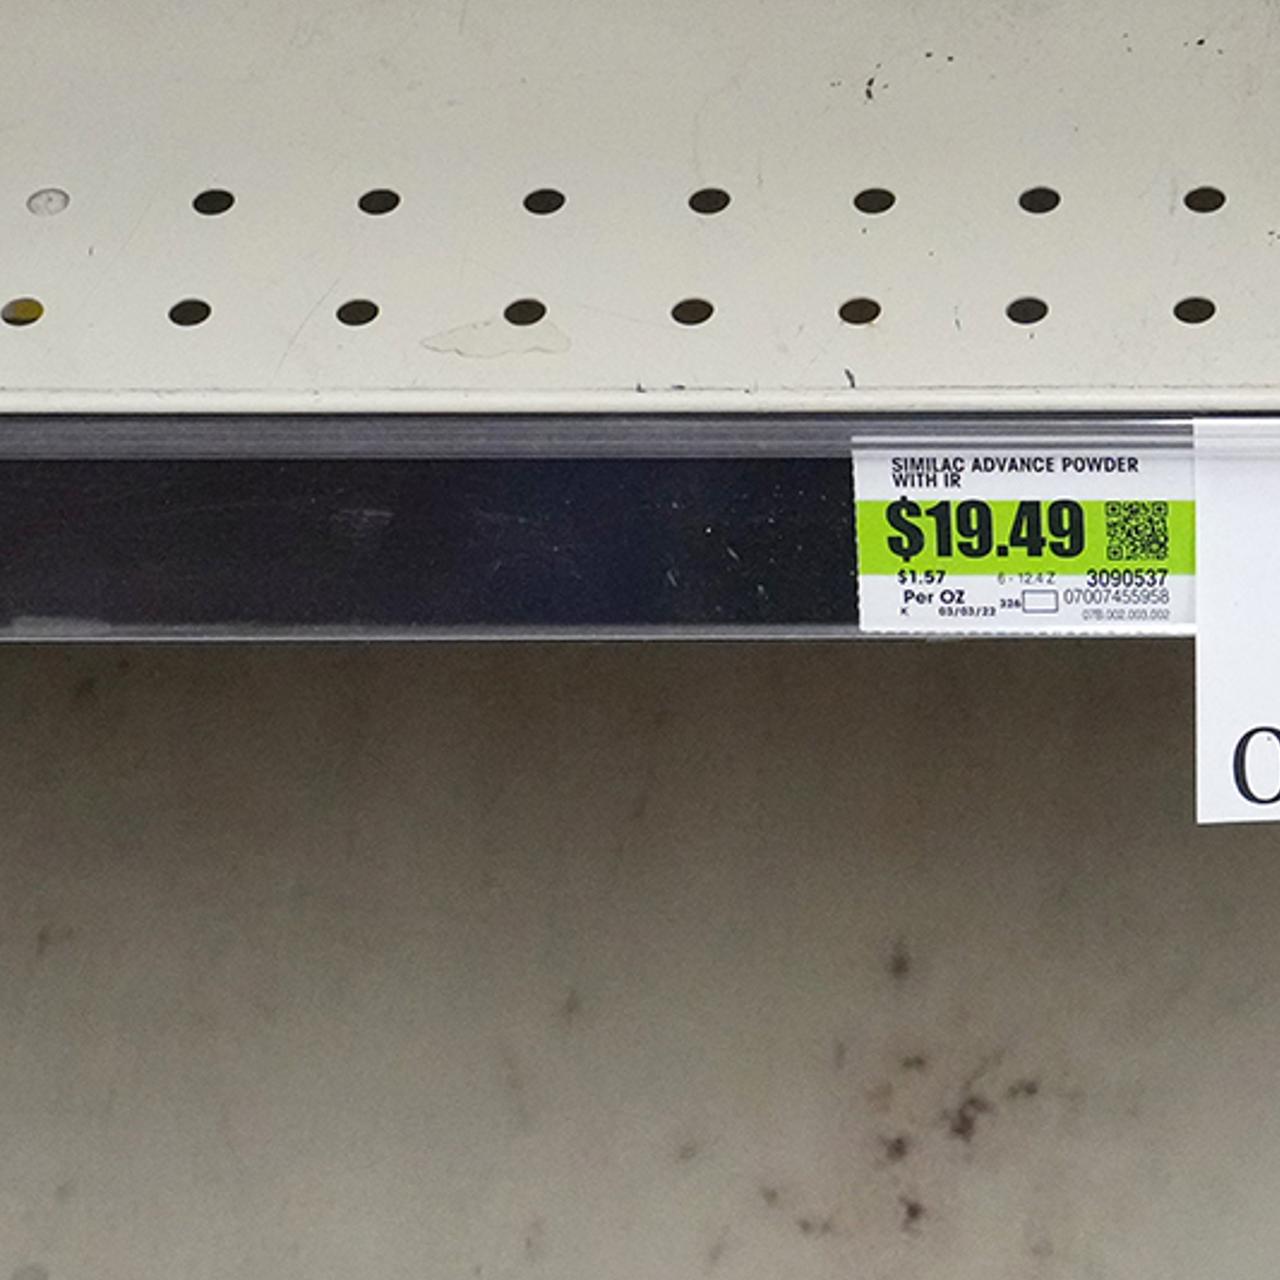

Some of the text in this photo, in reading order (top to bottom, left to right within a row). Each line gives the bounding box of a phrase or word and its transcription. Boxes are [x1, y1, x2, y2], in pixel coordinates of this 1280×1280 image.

[892, 457, 1139, 473] SIMILAC ADVANCE POWDER
[893, 473, 961, 488] WITH IR
[886, 496, 1085, 562] $19.49
[898, 570, 945, 585] $1.57
[1087, 570, 1168, 588] 3090537
[904, 590, 965, 604] Per OZ
[1064, 589, 1169, 605] 07007455958
